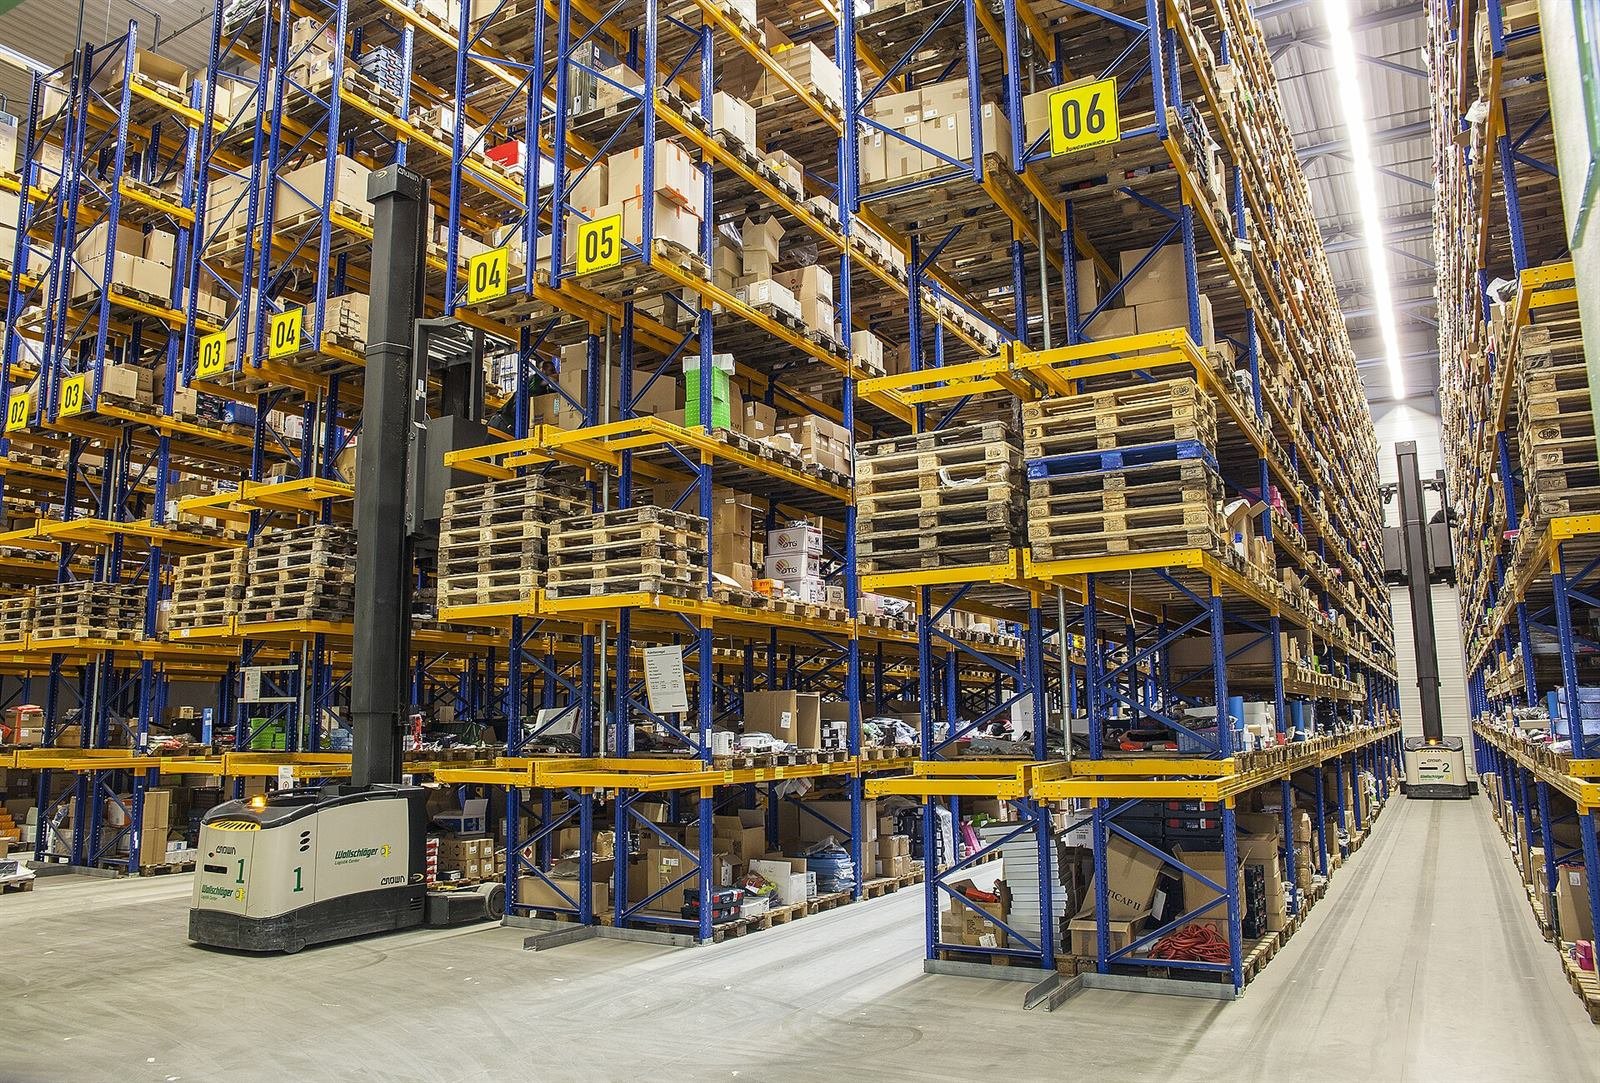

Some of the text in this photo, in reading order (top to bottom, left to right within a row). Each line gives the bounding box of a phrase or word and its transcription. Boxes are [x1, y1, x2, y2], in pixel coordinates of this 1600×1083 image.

[1062, 92, 1105, 139] 06
[586, 225, 613, 262] 05
[476, 258, 501, 292] 04
[276, 318, 295, 348] 04
[203, 340, 221, 368] 03
[64, 383, 79, 408] 03
[11, 400, 25, 424] 02
[1442, 763, 1450, 772] 2
[236, 859, 244, 883] 1
[293, 866, 304, 892] 1
